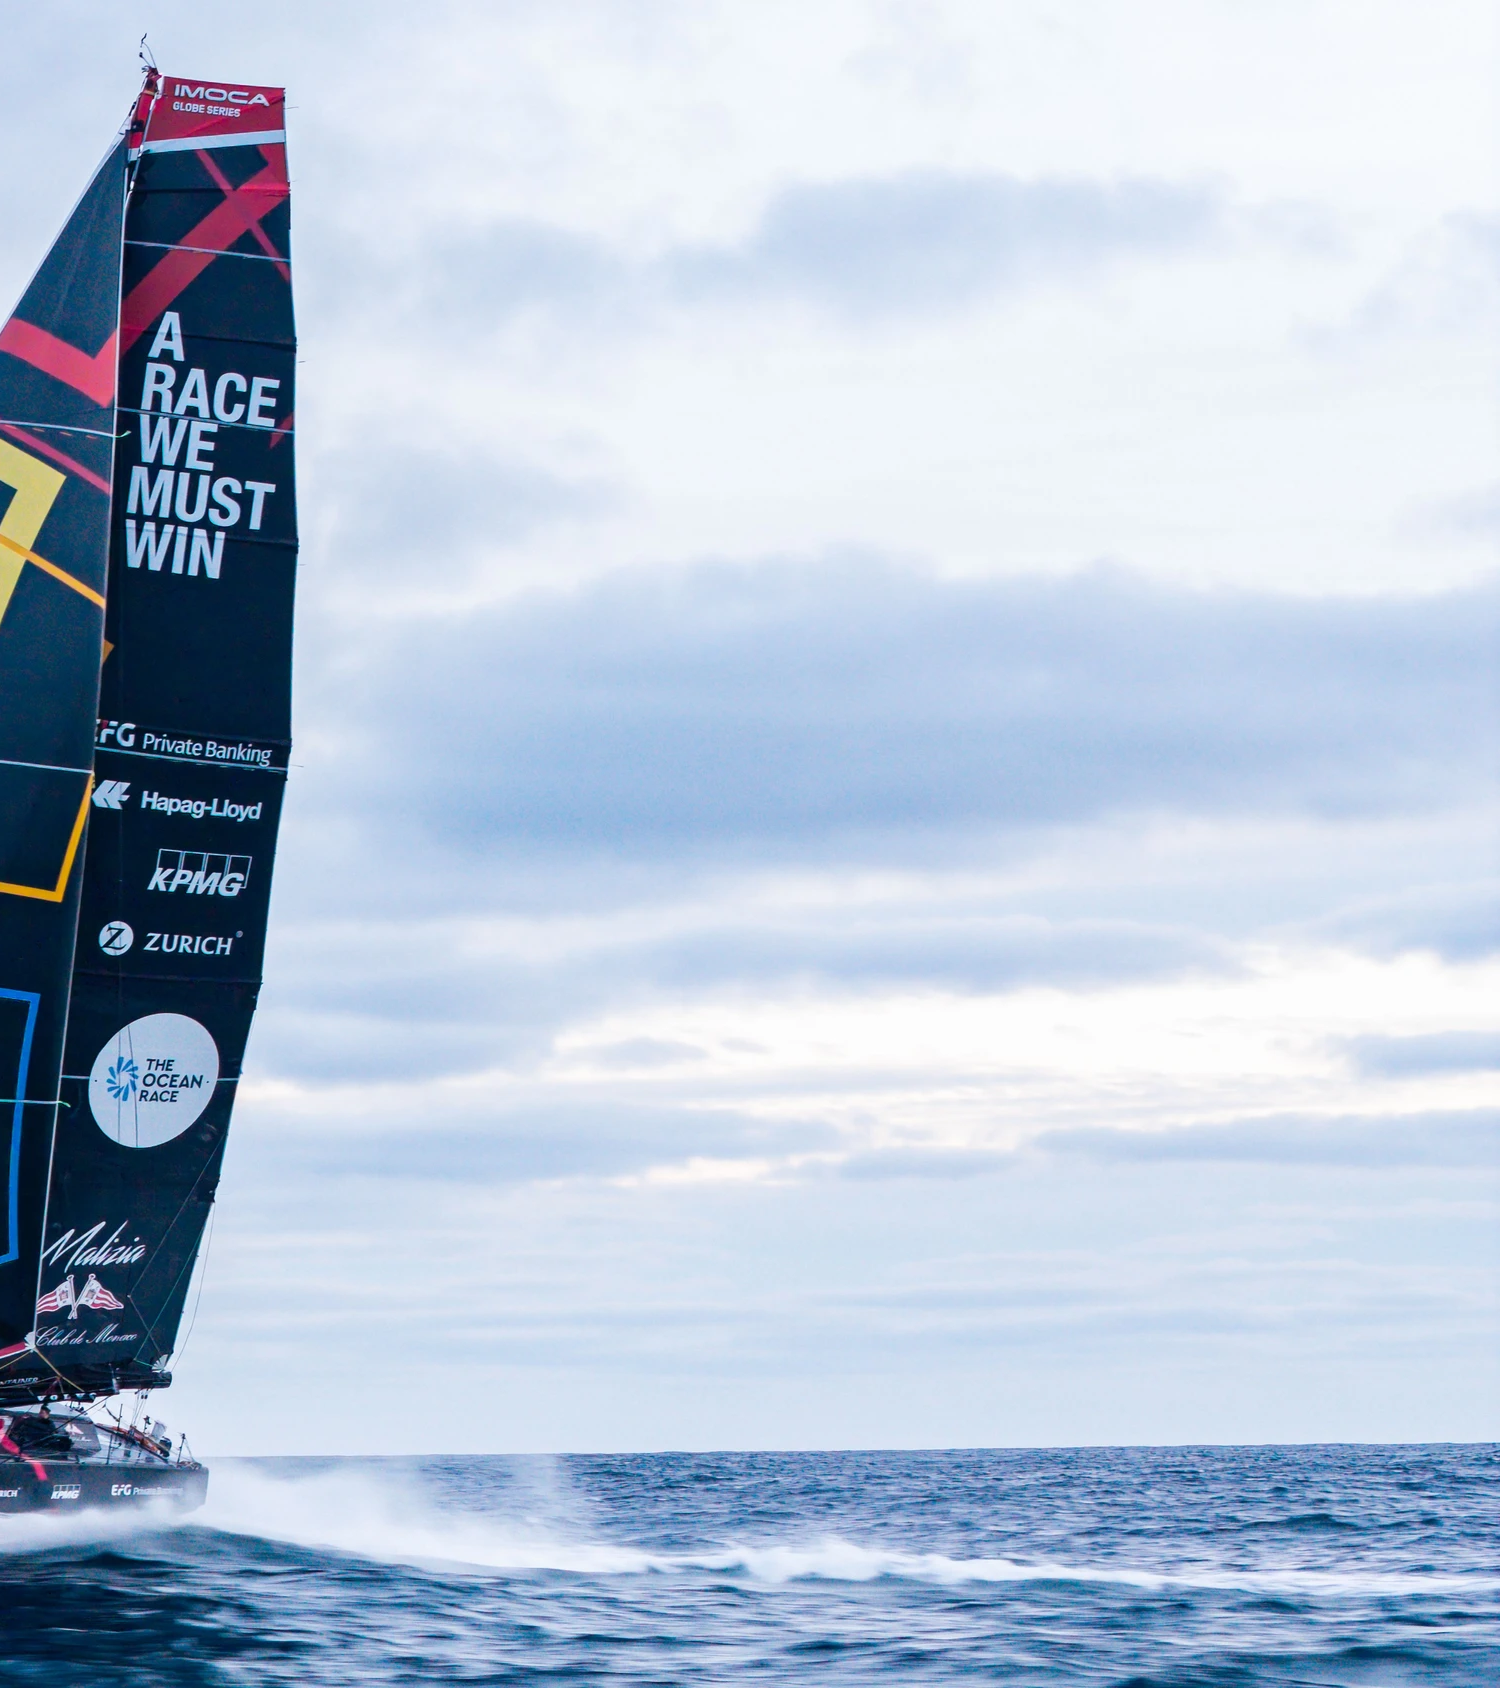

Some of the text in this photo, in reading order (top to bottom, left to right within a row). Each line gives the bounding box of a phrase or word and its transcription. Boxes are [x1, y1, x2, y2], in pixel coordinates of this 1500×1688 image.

[174, 84, 269, 107] IMOCA
[172, 101, 241, 118] GLOBE SERIES
[147, 311, 185, 362] A
[140, 362, 280, 427] RACE
[139, 413, 218, 472] WE
[126, 465, 276, 530] MUST
[125, 518, 226, 580] WIN
[142, 733, 203, 757] Private
[205, 741, 273, 767] Banking
[141, 790, 263, 822] Hapag-Lloyd
[147, 867, 245, 897] KPMG
[143, 932, 233, 955] ZURICH
[146, 1058, 175, 1071] THE
[142, 1073, 203, 1089] OCEAN
[138, 1090, 180, 1103] RACE
[51, 1490, 80, 1500] KPMG
[111, 1484, 132, 1496] EFG
